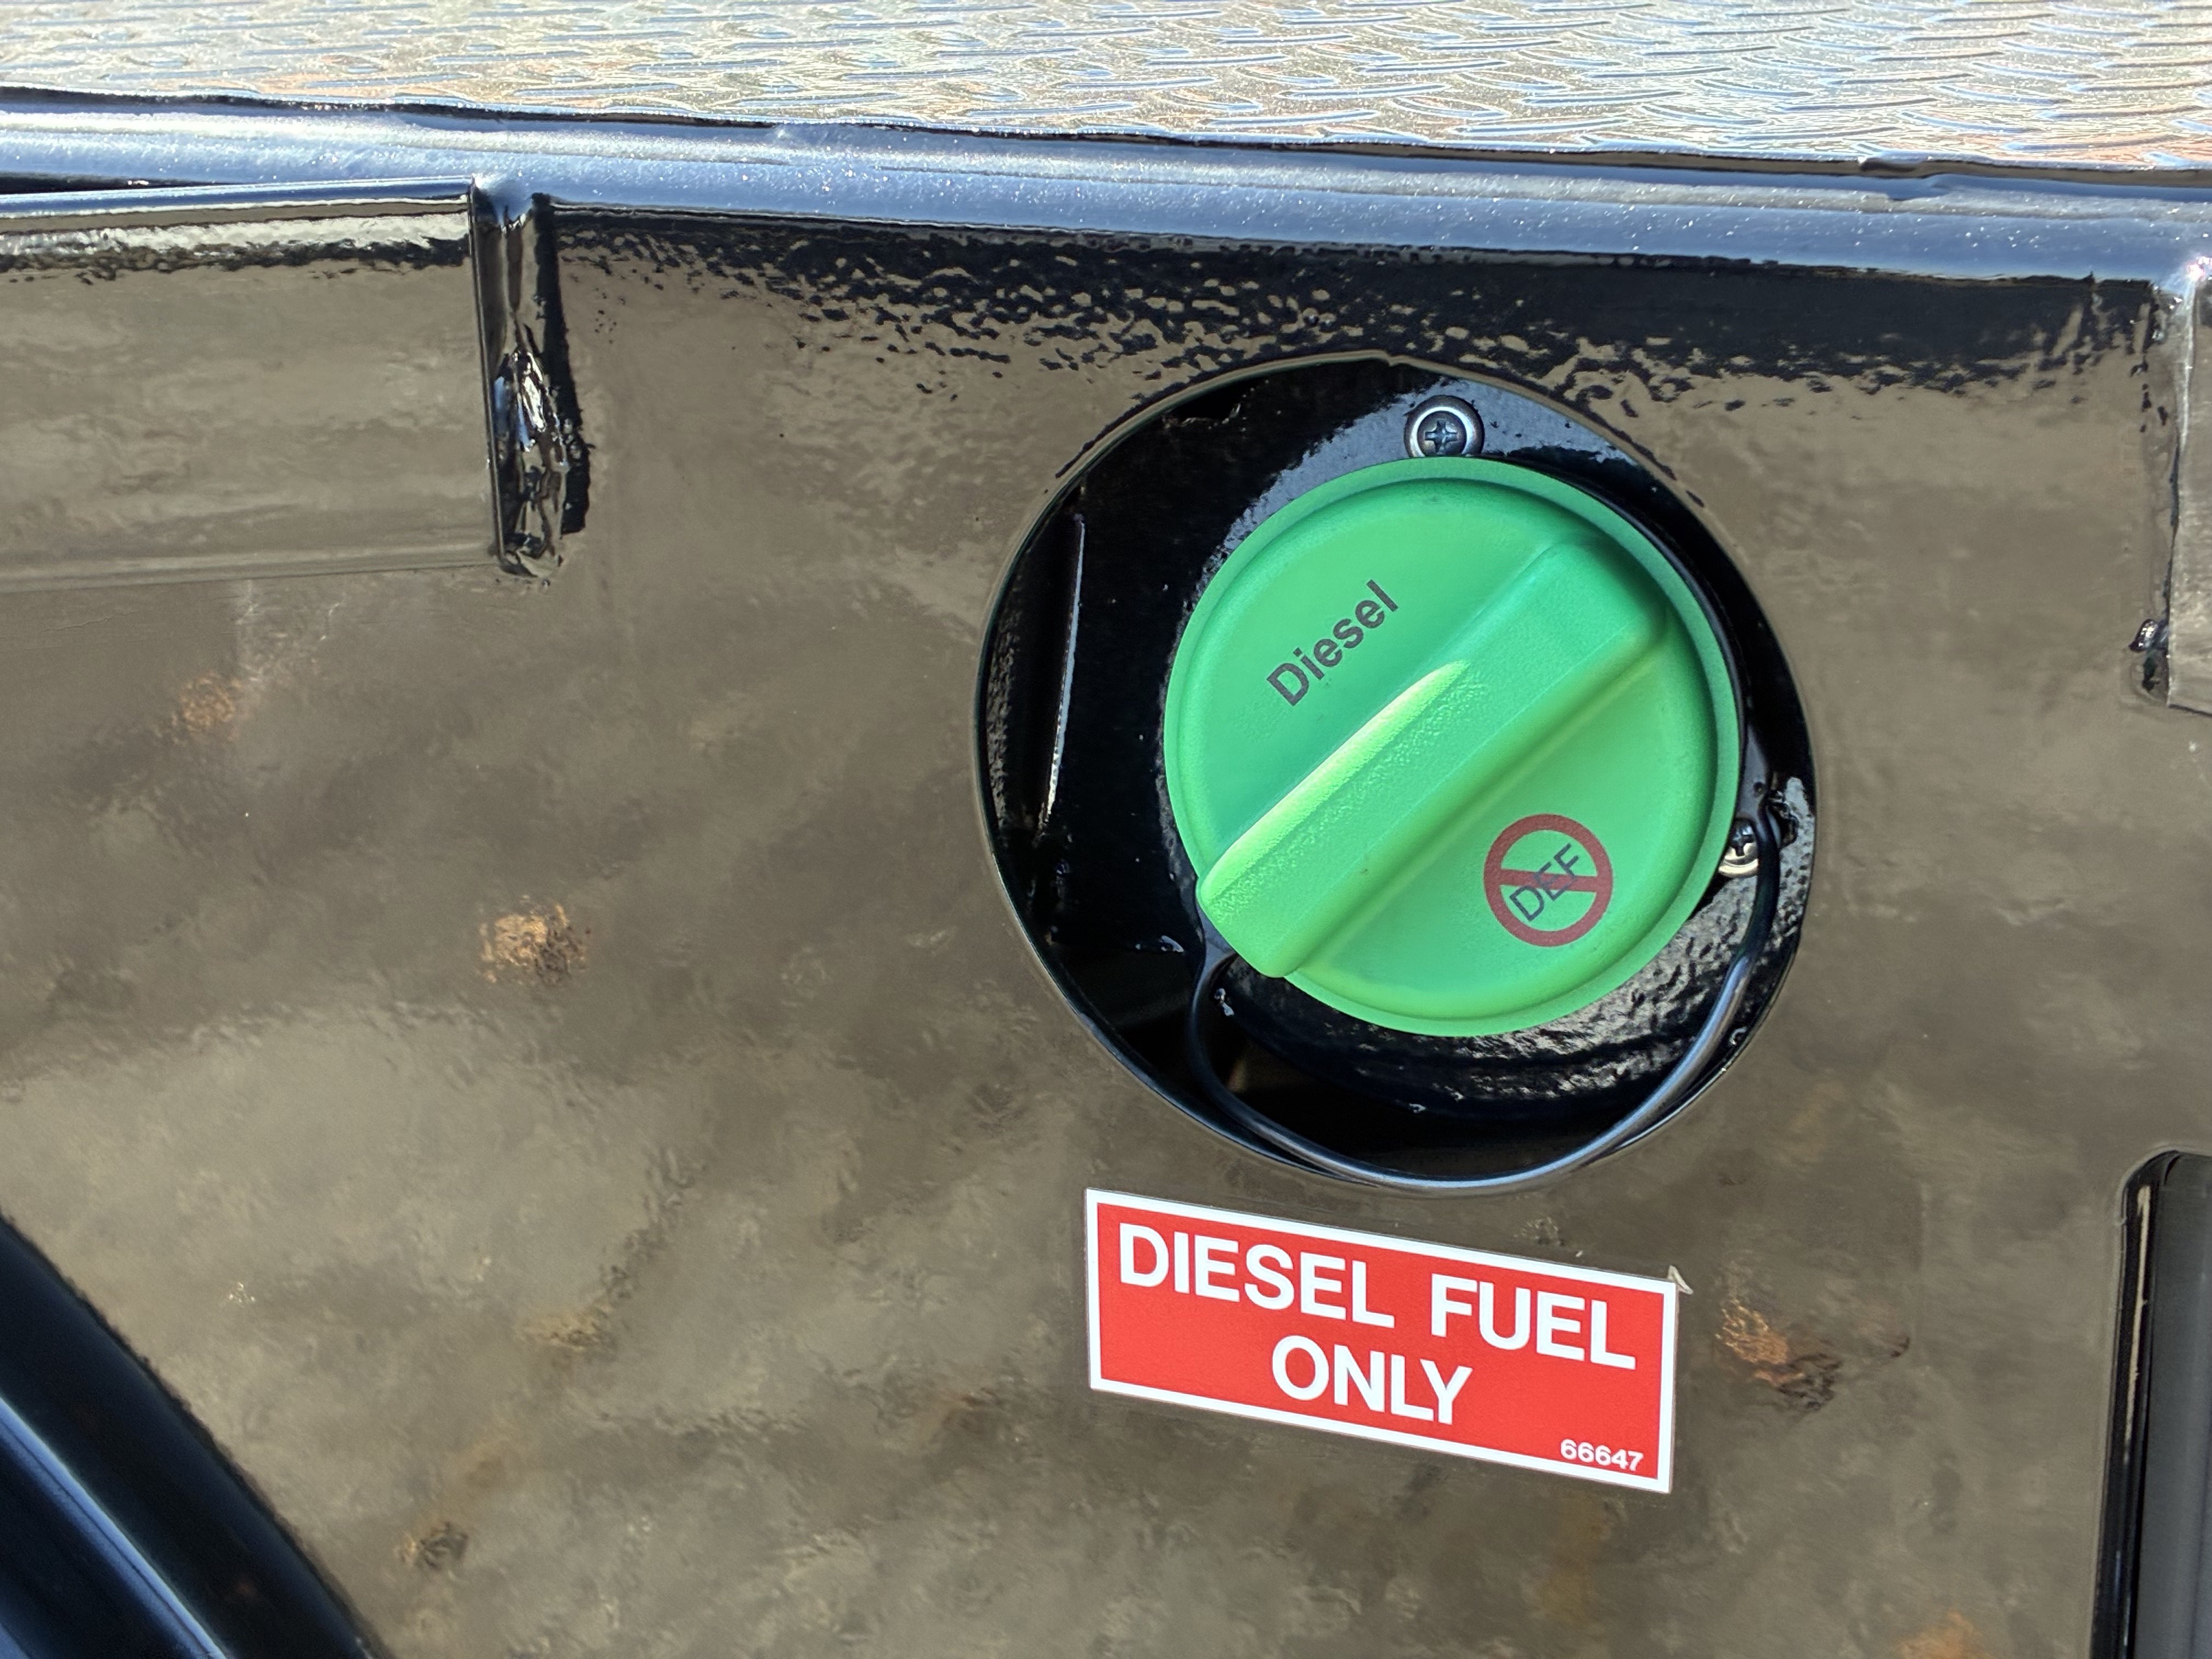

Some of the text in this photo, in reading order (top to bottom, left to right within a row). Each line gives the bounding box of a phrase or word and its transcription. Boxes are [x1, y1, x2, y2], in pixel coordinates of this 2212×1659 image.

[1266, 579, 1398, 707] Diesel
[1510, 843, 1579, 922] DEF
[1119, 1222, 1636, 1370] DIESEL FUEL
[1272, 1335, 1473, 1425] ONLY
[1560, 1439, 1644, 1471] 66647
